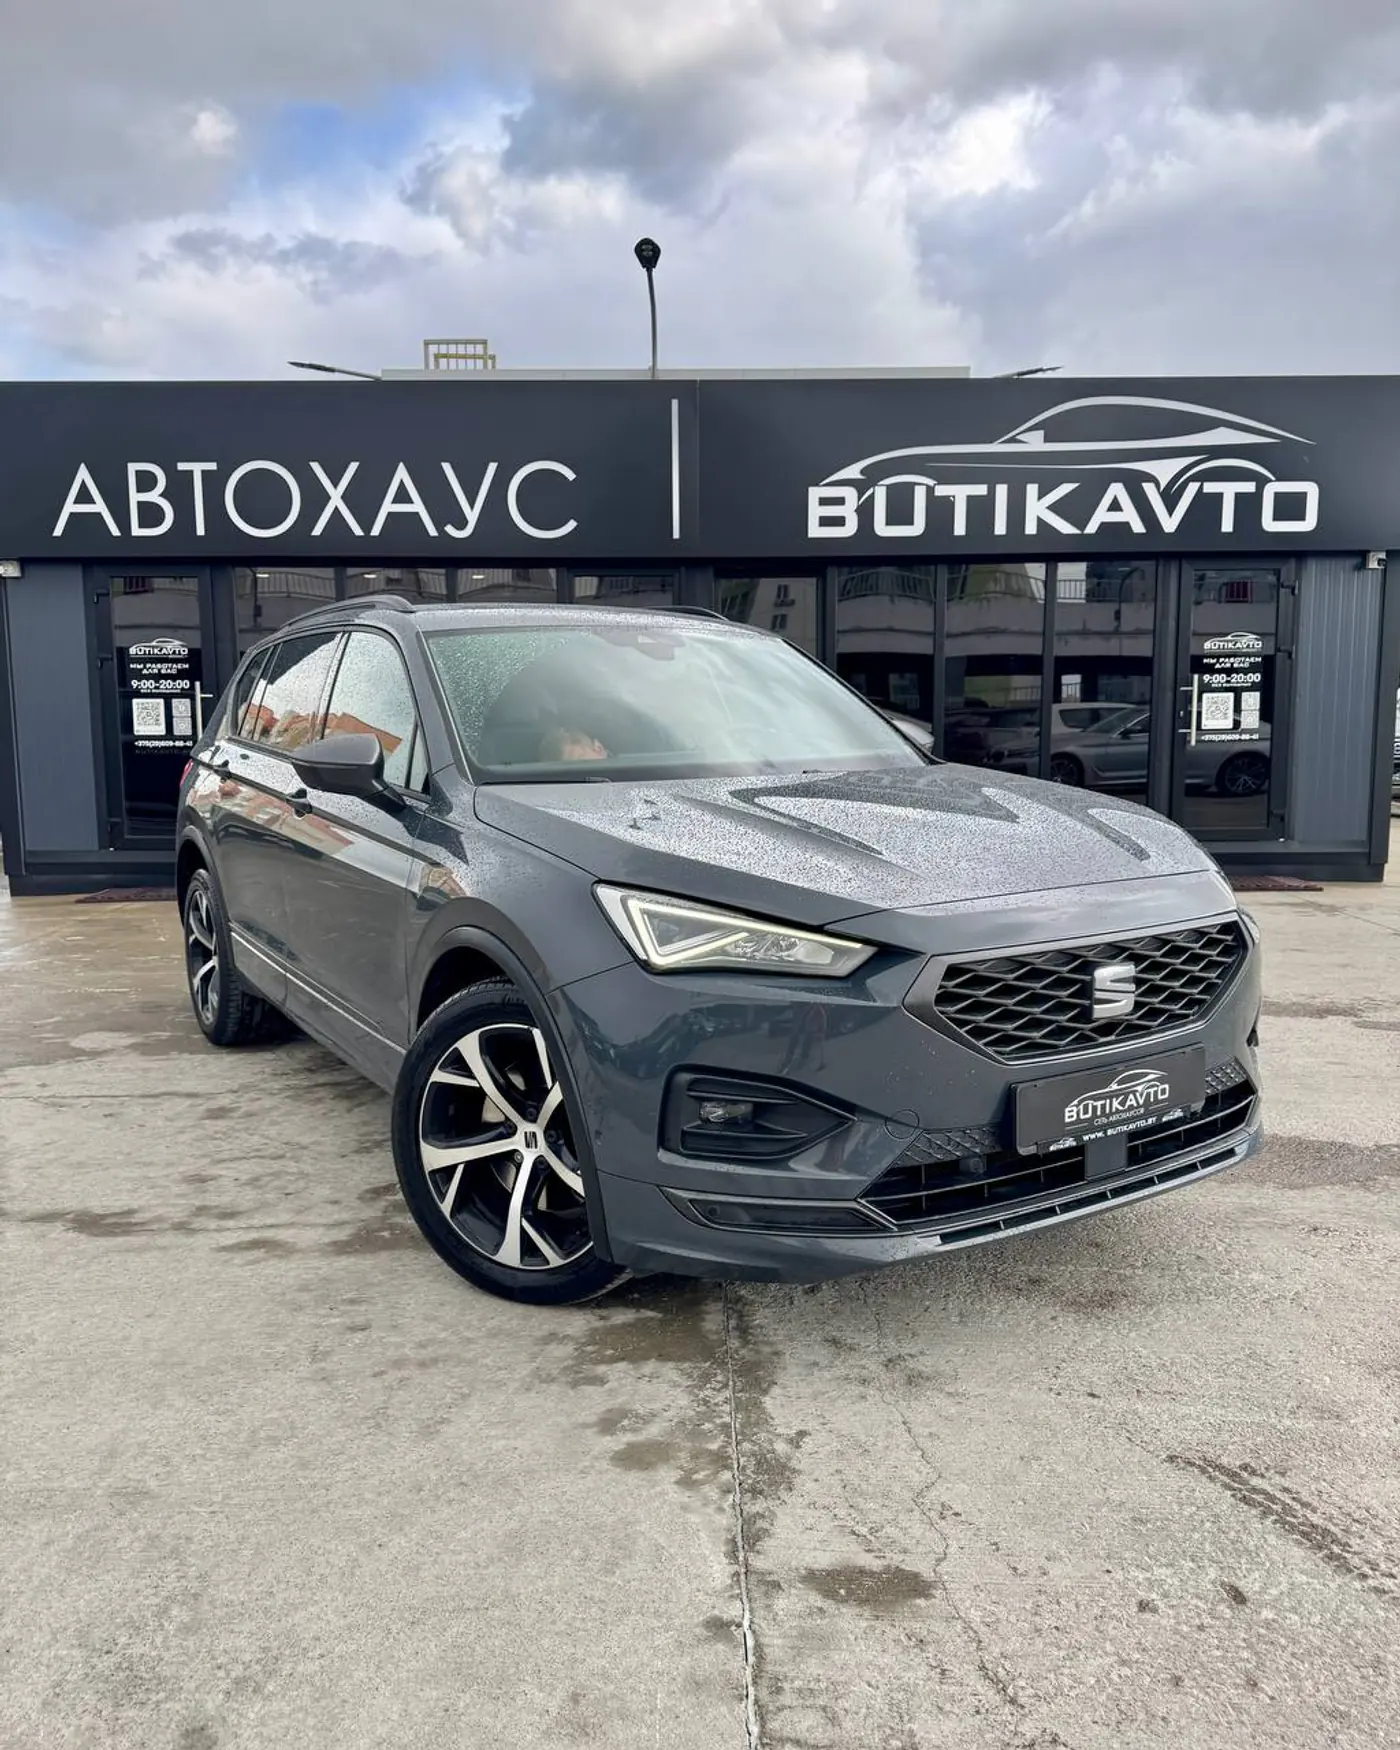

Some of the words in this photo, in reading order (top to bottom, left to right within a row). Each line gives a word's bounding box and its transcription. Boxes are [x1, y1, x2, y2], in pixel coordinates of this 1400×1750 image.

[52, 460, 578, 539] АВТОХАУС
[807, 481, 1319, 539] BUTIKAVTO
[129, 647, 189, 655] BUTIKAVTO
[1203, 641, 1262, 650] BUTIKAVTO
[131, 680, 190, 689] 9:00-20:00
[1203, 673, 1261, 683] 9:00-20:00
[1064, 1083, 1170, 1123] BUTIKAVTO
[1106, 1116, 1157, 1136] BUTIKAVTO.BY
